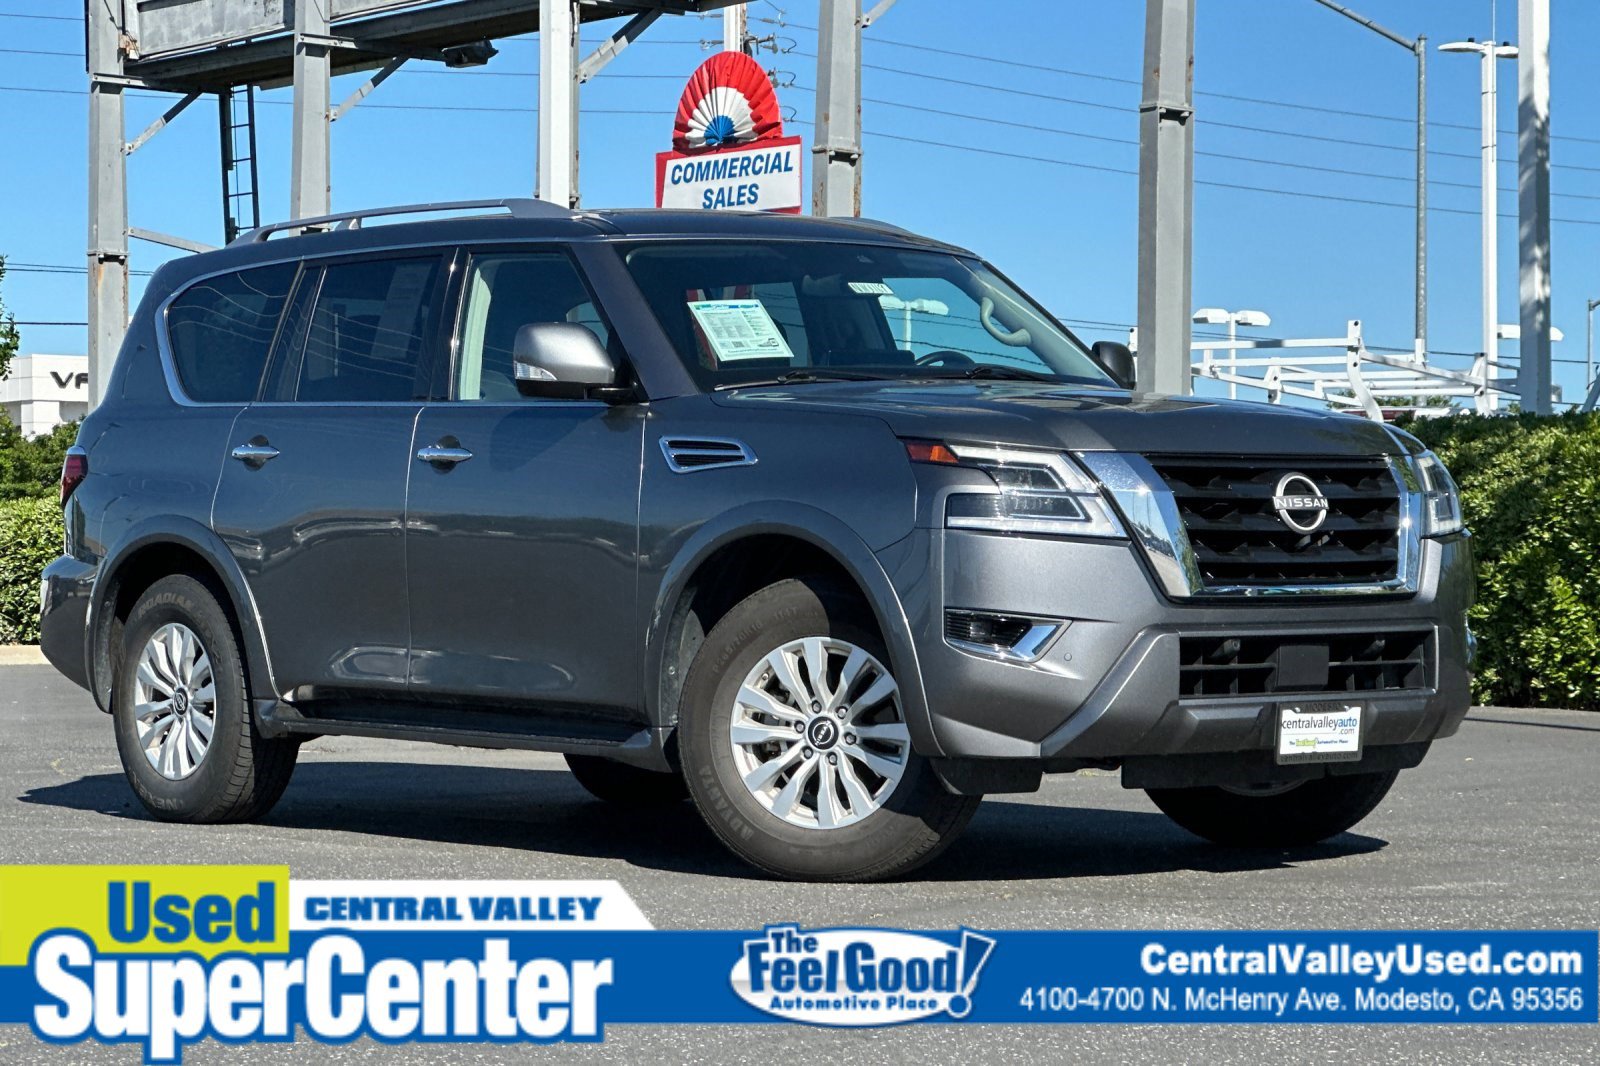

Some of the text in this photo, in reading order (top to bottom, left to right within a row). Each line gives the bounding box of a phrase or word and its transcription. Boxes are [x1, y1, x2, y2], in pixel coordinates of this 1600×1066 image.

[671, 151, 793, 185] COMMERCIAL
[702, 183, 760, 209] SALES
[1275, 498, 1329, 508] NISSAN
[1282, 716, 1358, 731] centralvalleyauto
